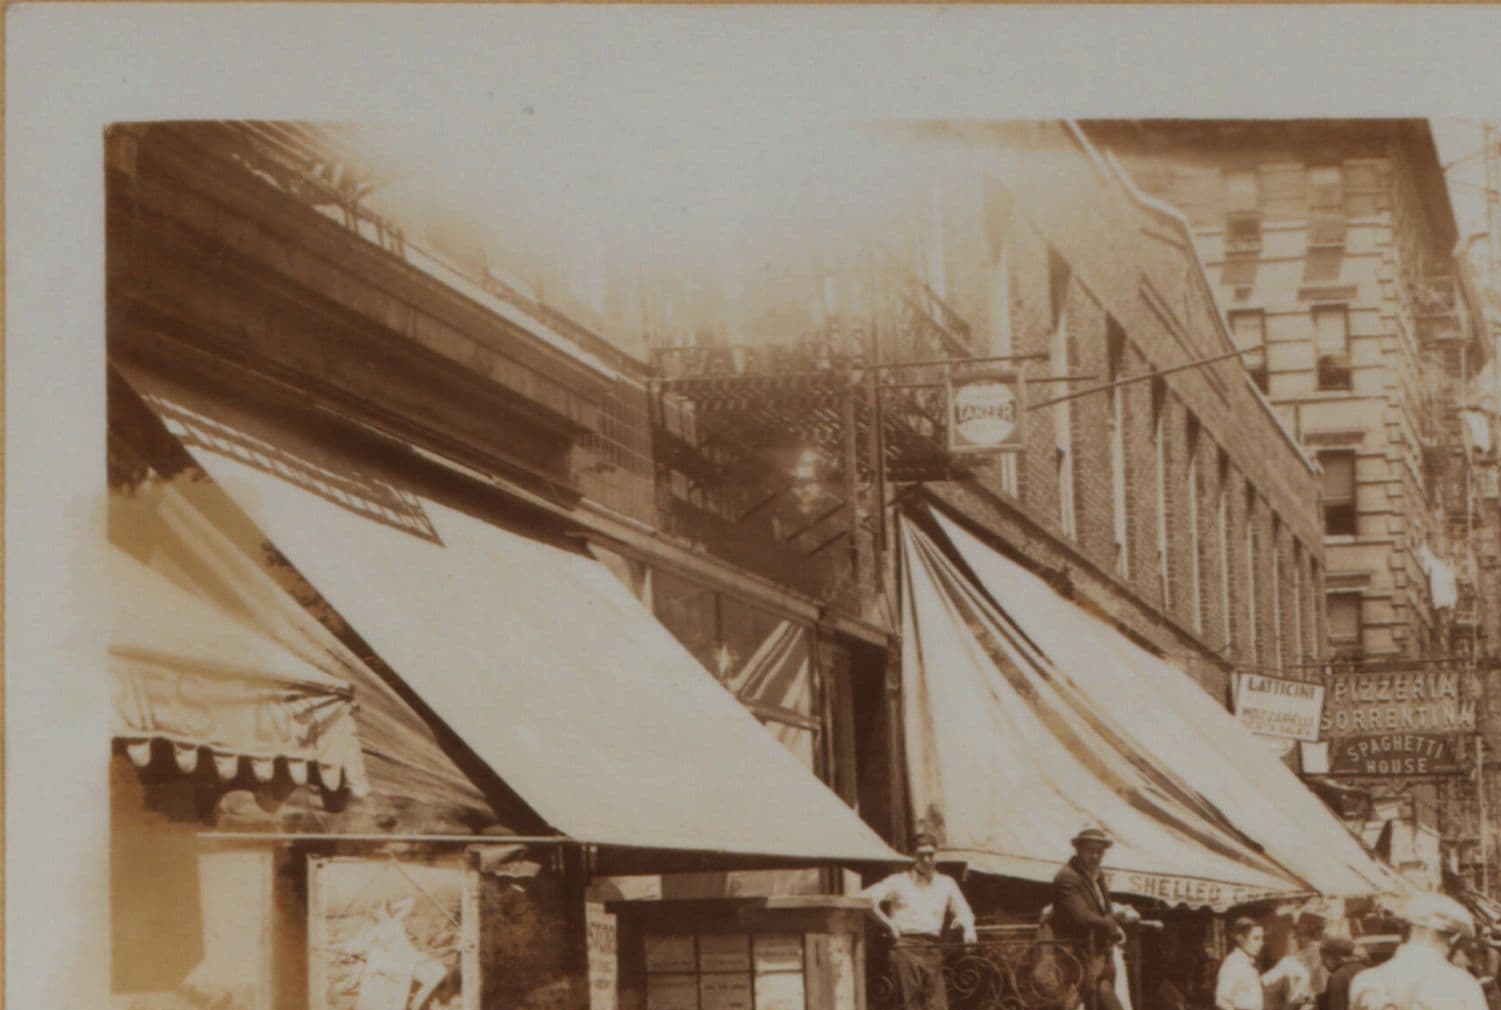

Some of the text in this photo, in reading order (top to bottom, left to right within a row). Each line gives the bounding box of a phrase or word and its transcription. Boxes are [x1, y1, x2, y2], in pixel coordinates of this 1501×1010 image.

[1335, 674, 1457, 701] PIZZERIA
[1320, 700, 1476, 732] SORRENTINA
[1348, 735, 1444, 762] SPAGHETTI
[1366, 758, 1428, 774] HOUSE
[1129, 875, 1221, 902] SHELLED
